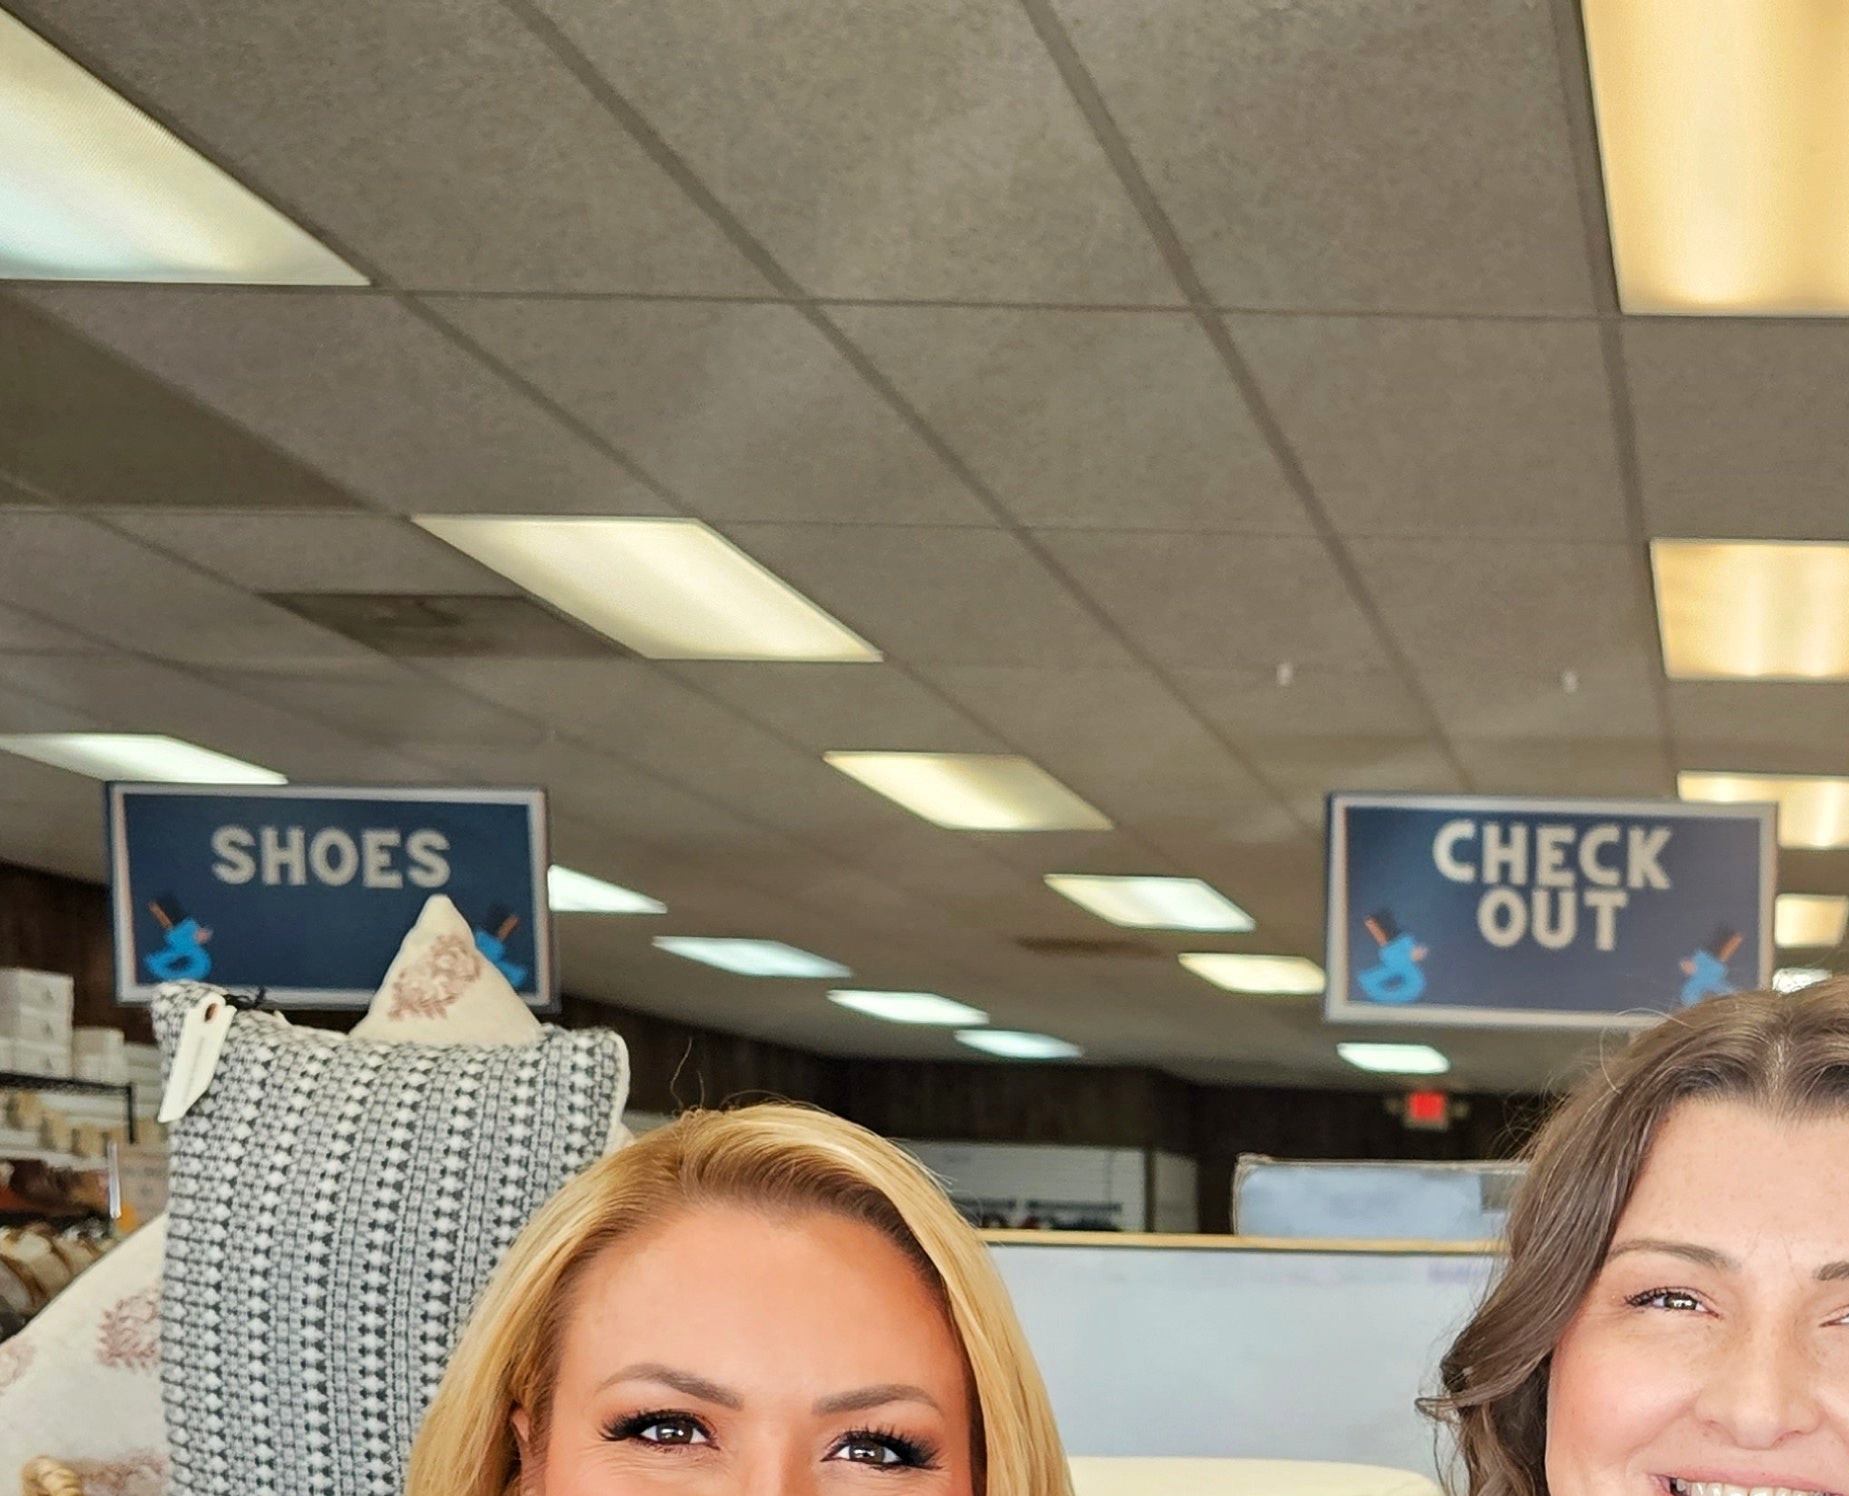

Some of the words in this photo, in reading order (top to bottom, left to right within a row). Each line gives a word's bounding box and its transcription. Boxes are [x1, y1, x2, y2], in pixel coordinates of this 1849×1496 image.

[211, 825, 451, 888] SHOES
[1433, 821, 1673, 889] CHECK
[1477, 886, 1629, 950] OUT
